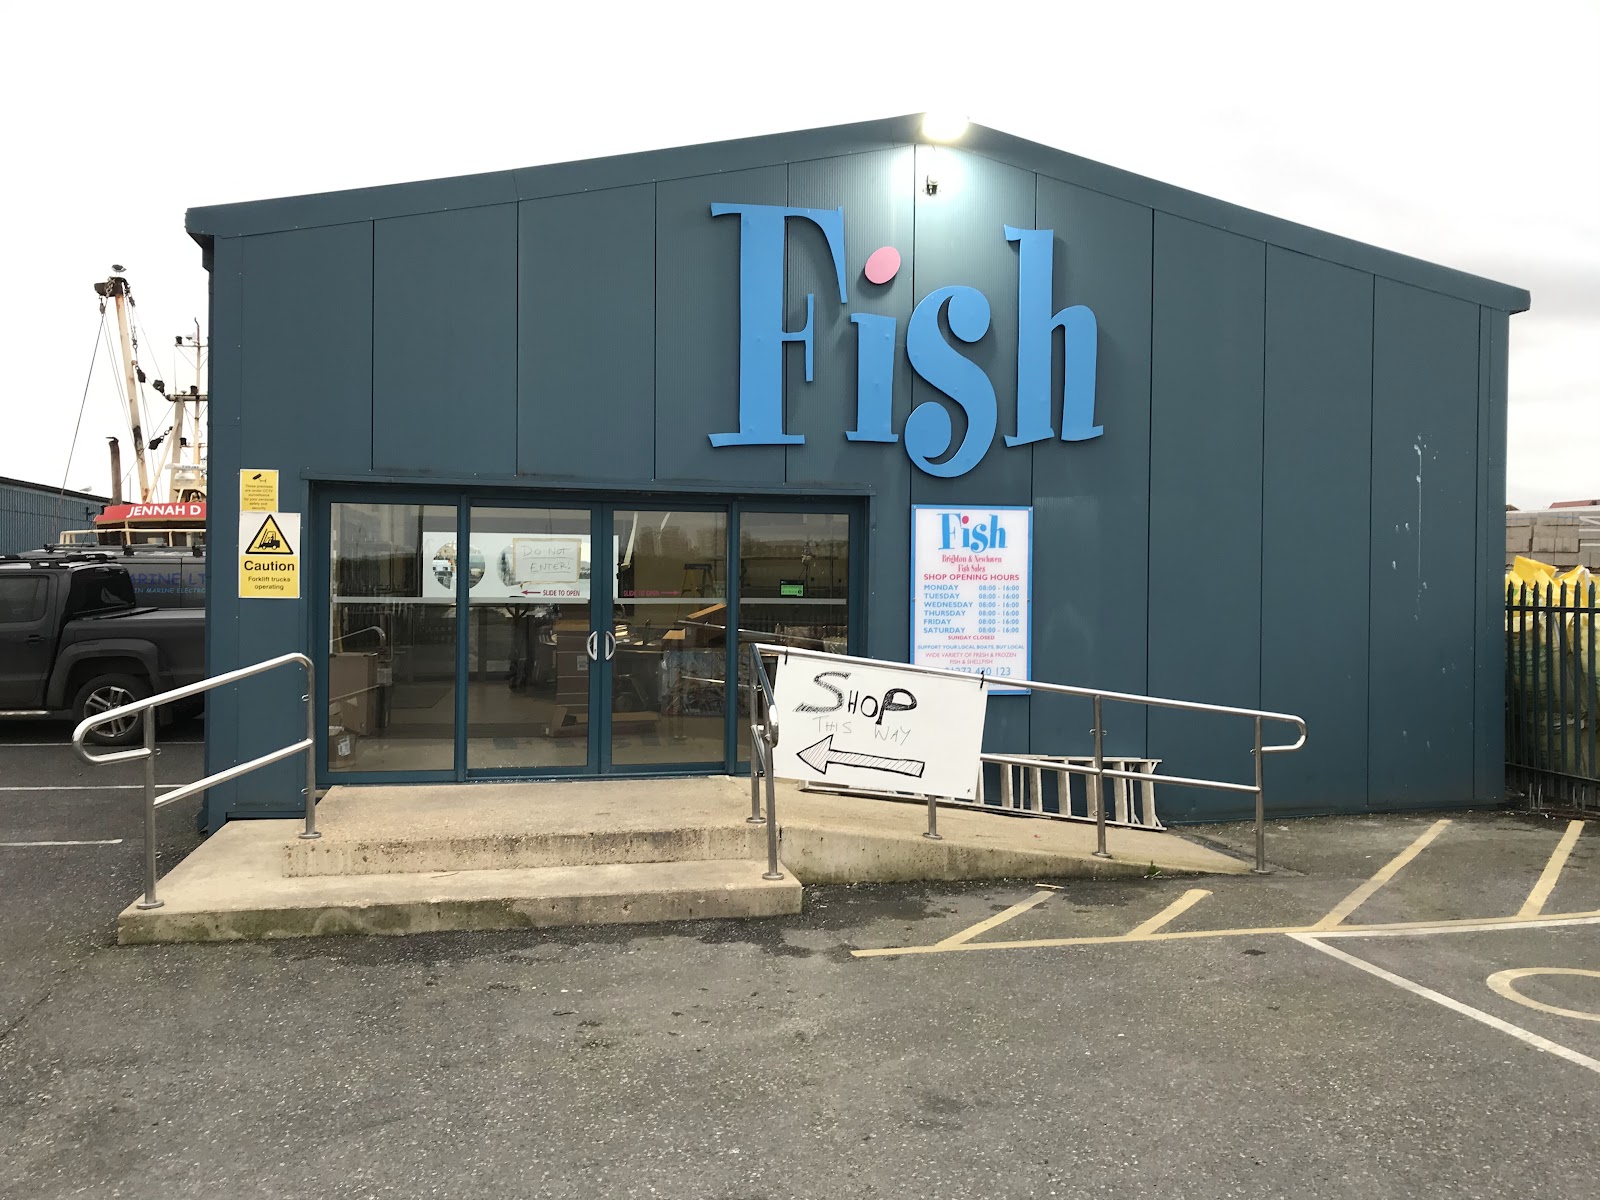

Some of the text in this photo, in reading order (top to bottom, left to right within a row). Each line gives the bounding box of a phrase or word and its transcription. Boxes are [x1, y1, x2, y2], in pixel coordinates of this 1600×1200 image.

[707, 202, 1104, 478] Fish
[126, 505, 202, 518] JENNAH D
[937, 512, 1008, 553] Fish
[521, 545, 542, 556] DO
[942, 554, 967, 564] Brighton
[244, 560, 295, 571] Caution
[971, 564, 986, 573] Sales
[996, 667, 1011, 676] 123
[792, 671, 918, 725] SHOP
[812, 715, 912, 746] THIS WAY
